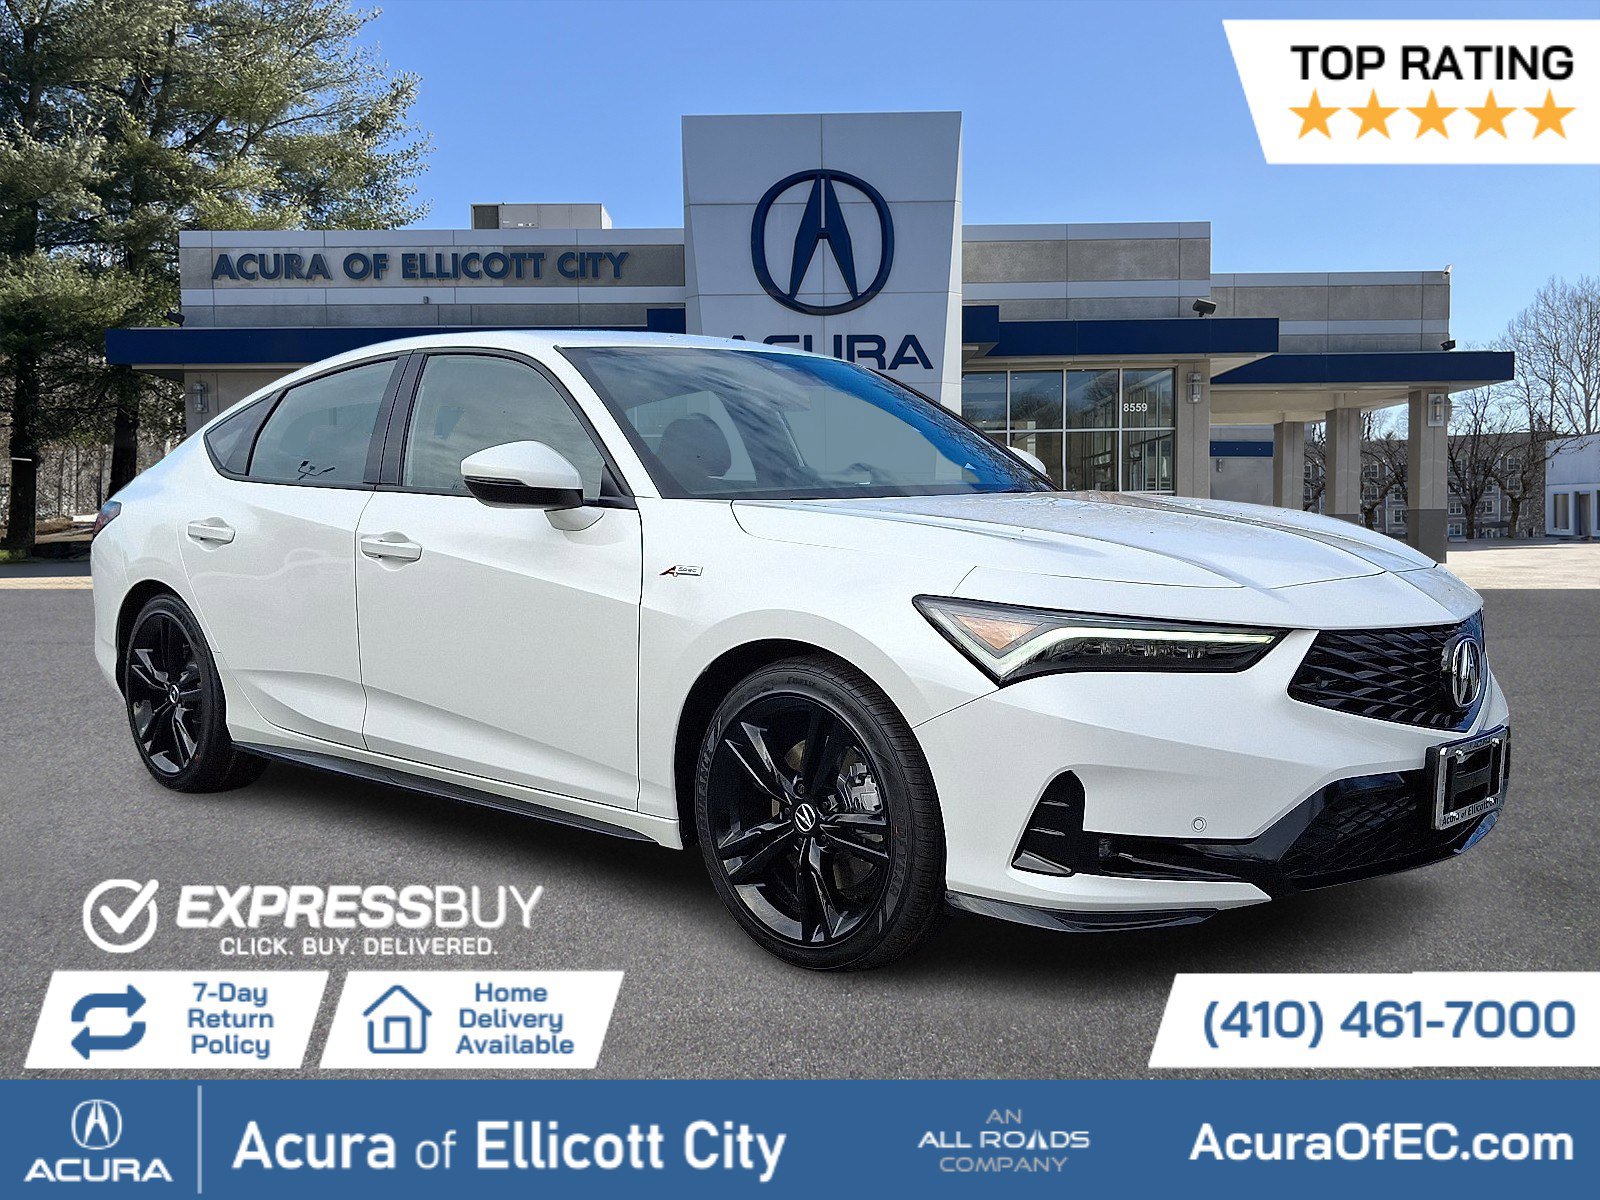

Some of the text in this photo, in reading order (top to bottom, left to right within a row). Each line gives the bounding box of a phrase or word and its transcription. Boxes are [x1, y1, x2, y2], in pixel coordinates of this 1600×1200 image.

[211, 251, 630, 281] ACURA OF ELLICOTT CITY
[1123, 402, 1148, 413] 8559
